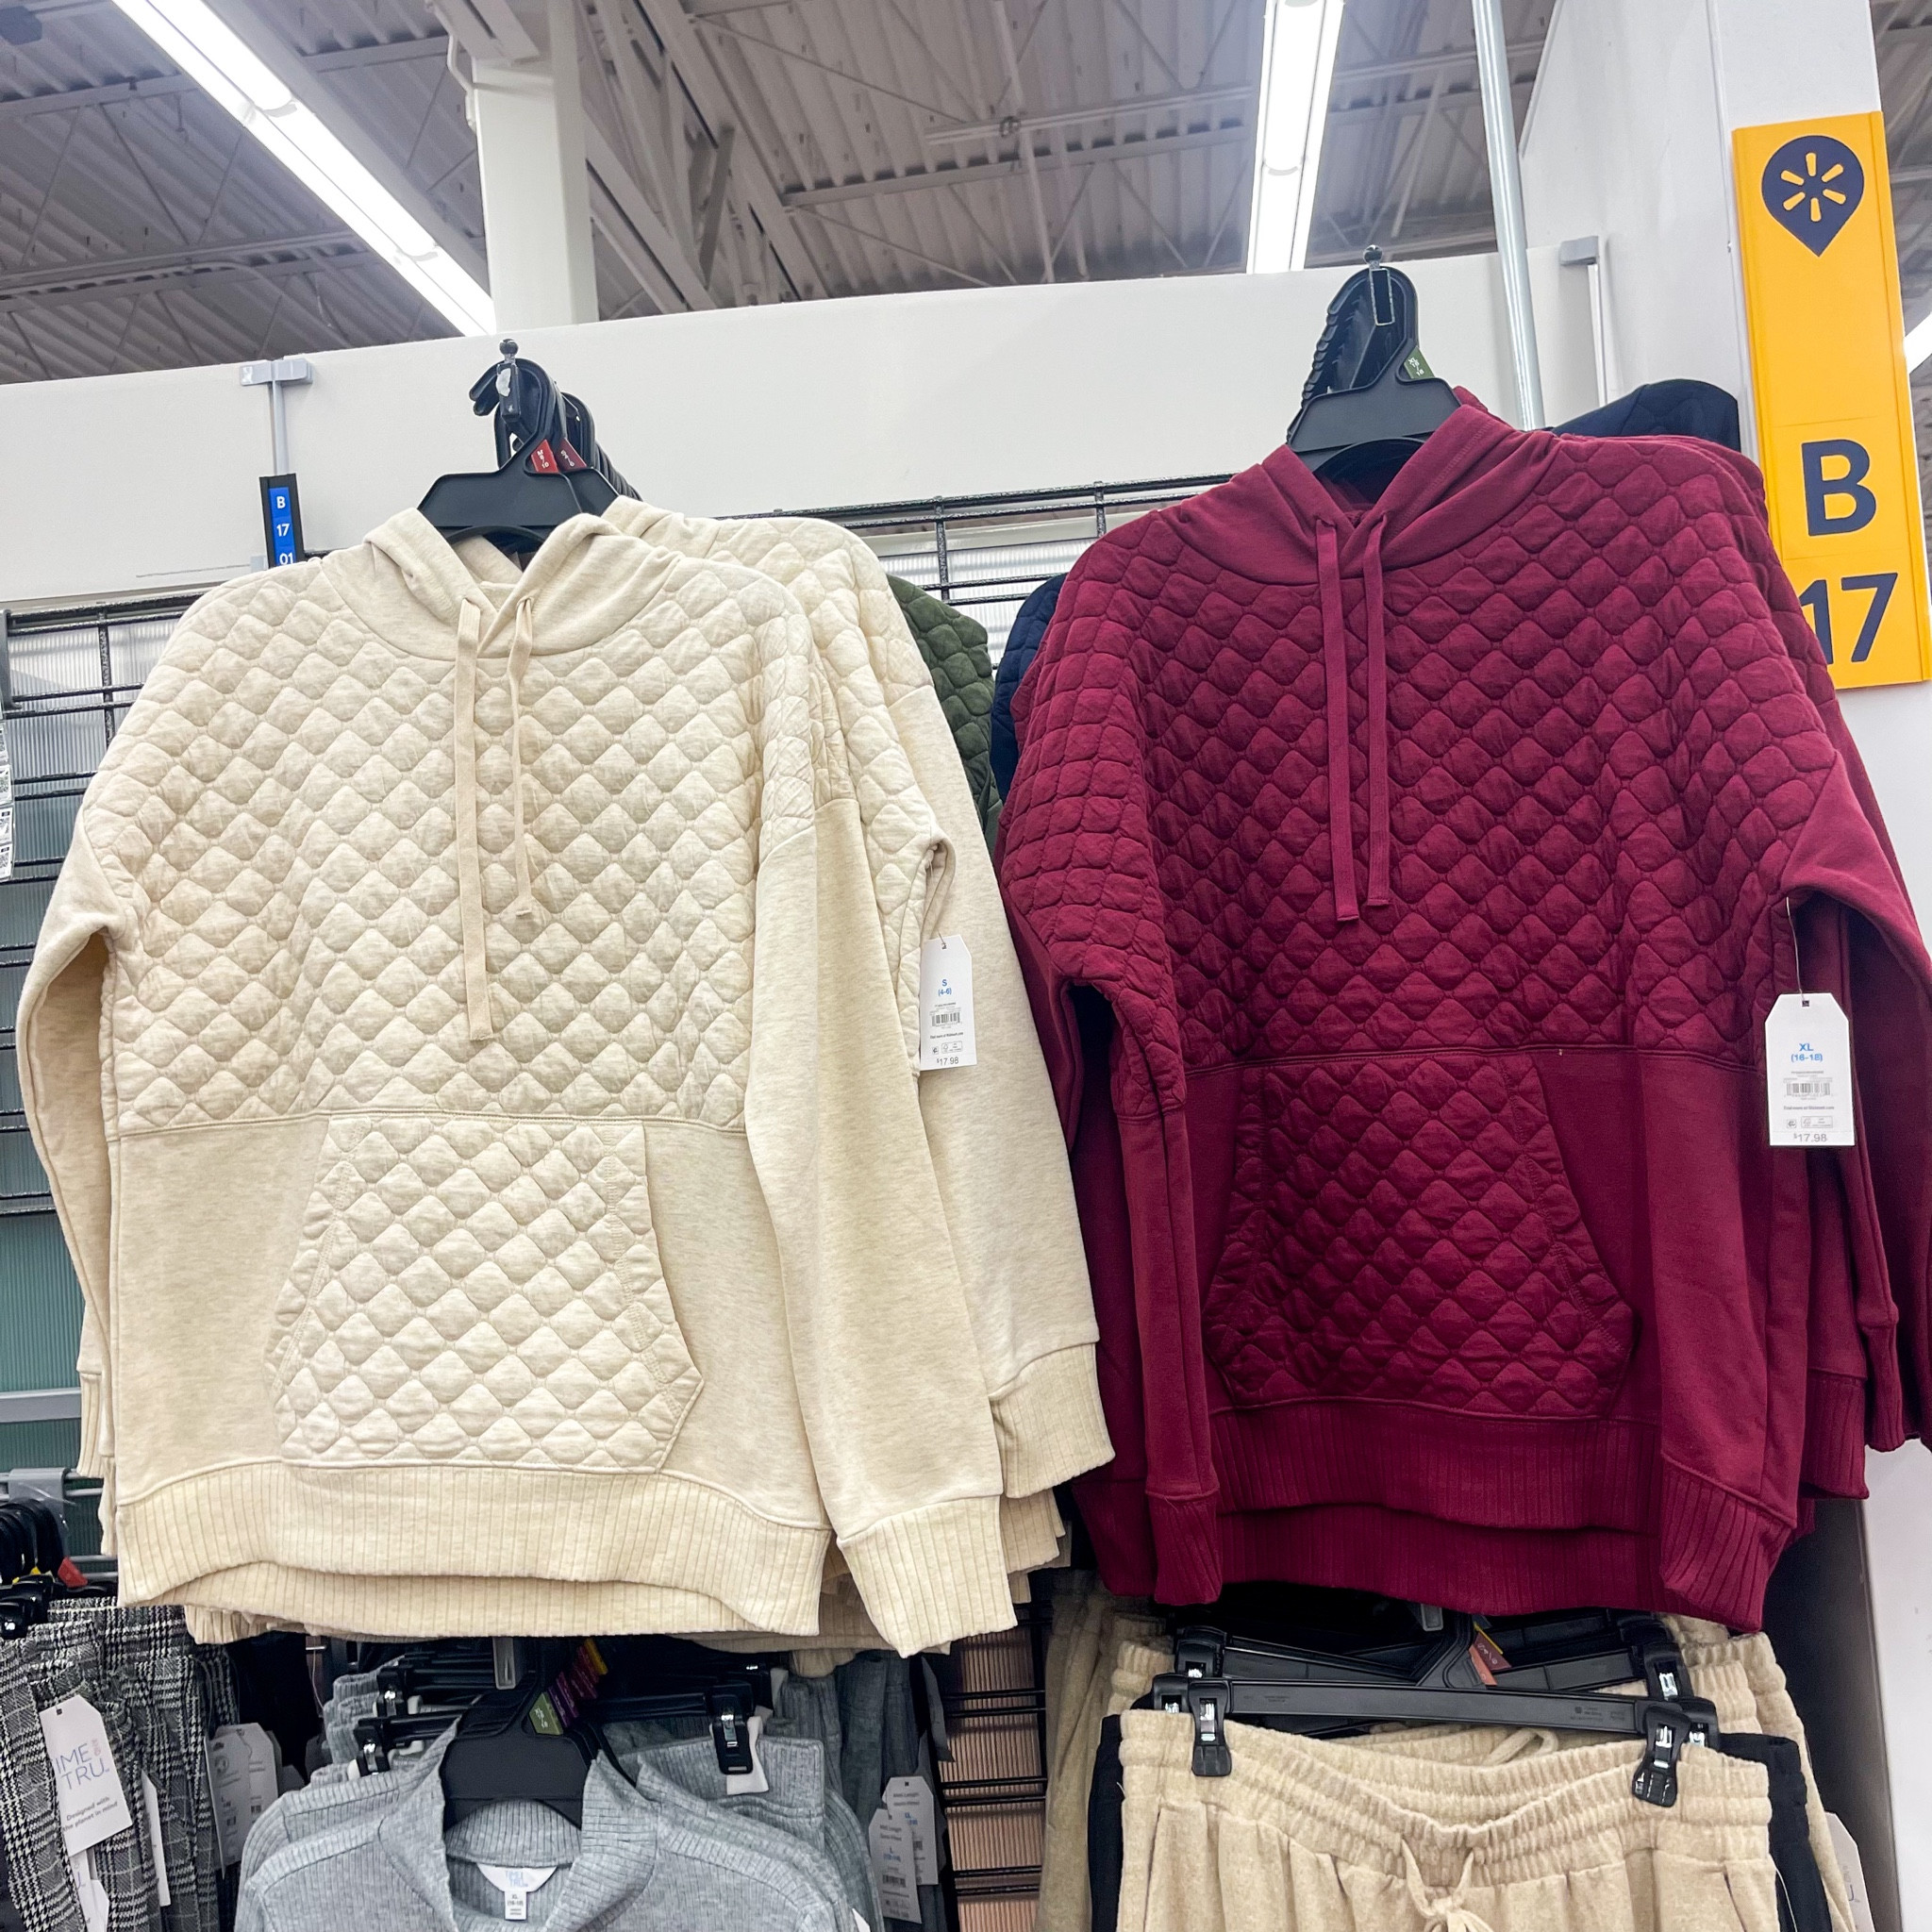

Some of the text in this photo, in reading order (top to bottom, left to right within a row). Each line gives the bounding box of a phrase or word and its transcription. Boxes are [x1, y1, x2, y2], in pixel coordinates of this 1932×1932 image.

[540, 454, 550, 469] 8/10
[1801, 439, 1877, 538] B
[276, 496, 286, 509] B
[276, 524, 290, 537] 17
[279, 553, 293, 565] 01
[1797, 572, 1899, 666] 17
[941, 978, 948, 987] S
[938, 987, 952, 996] (4-6)
[1798, 1042, 1814, 1052] XL
[1790, 1053, 1824, 1062] (16-18)
[1792, 1132, 1827, 1142] $17.98
[52, 1743, 92, 1774] IME
[61, 1758, 105, 1790] TRU
[66, 1796, 110, 1821] Designed with
[75, 1813, 94, 1828] planet
[103, 1801, 118, 1813] mind
